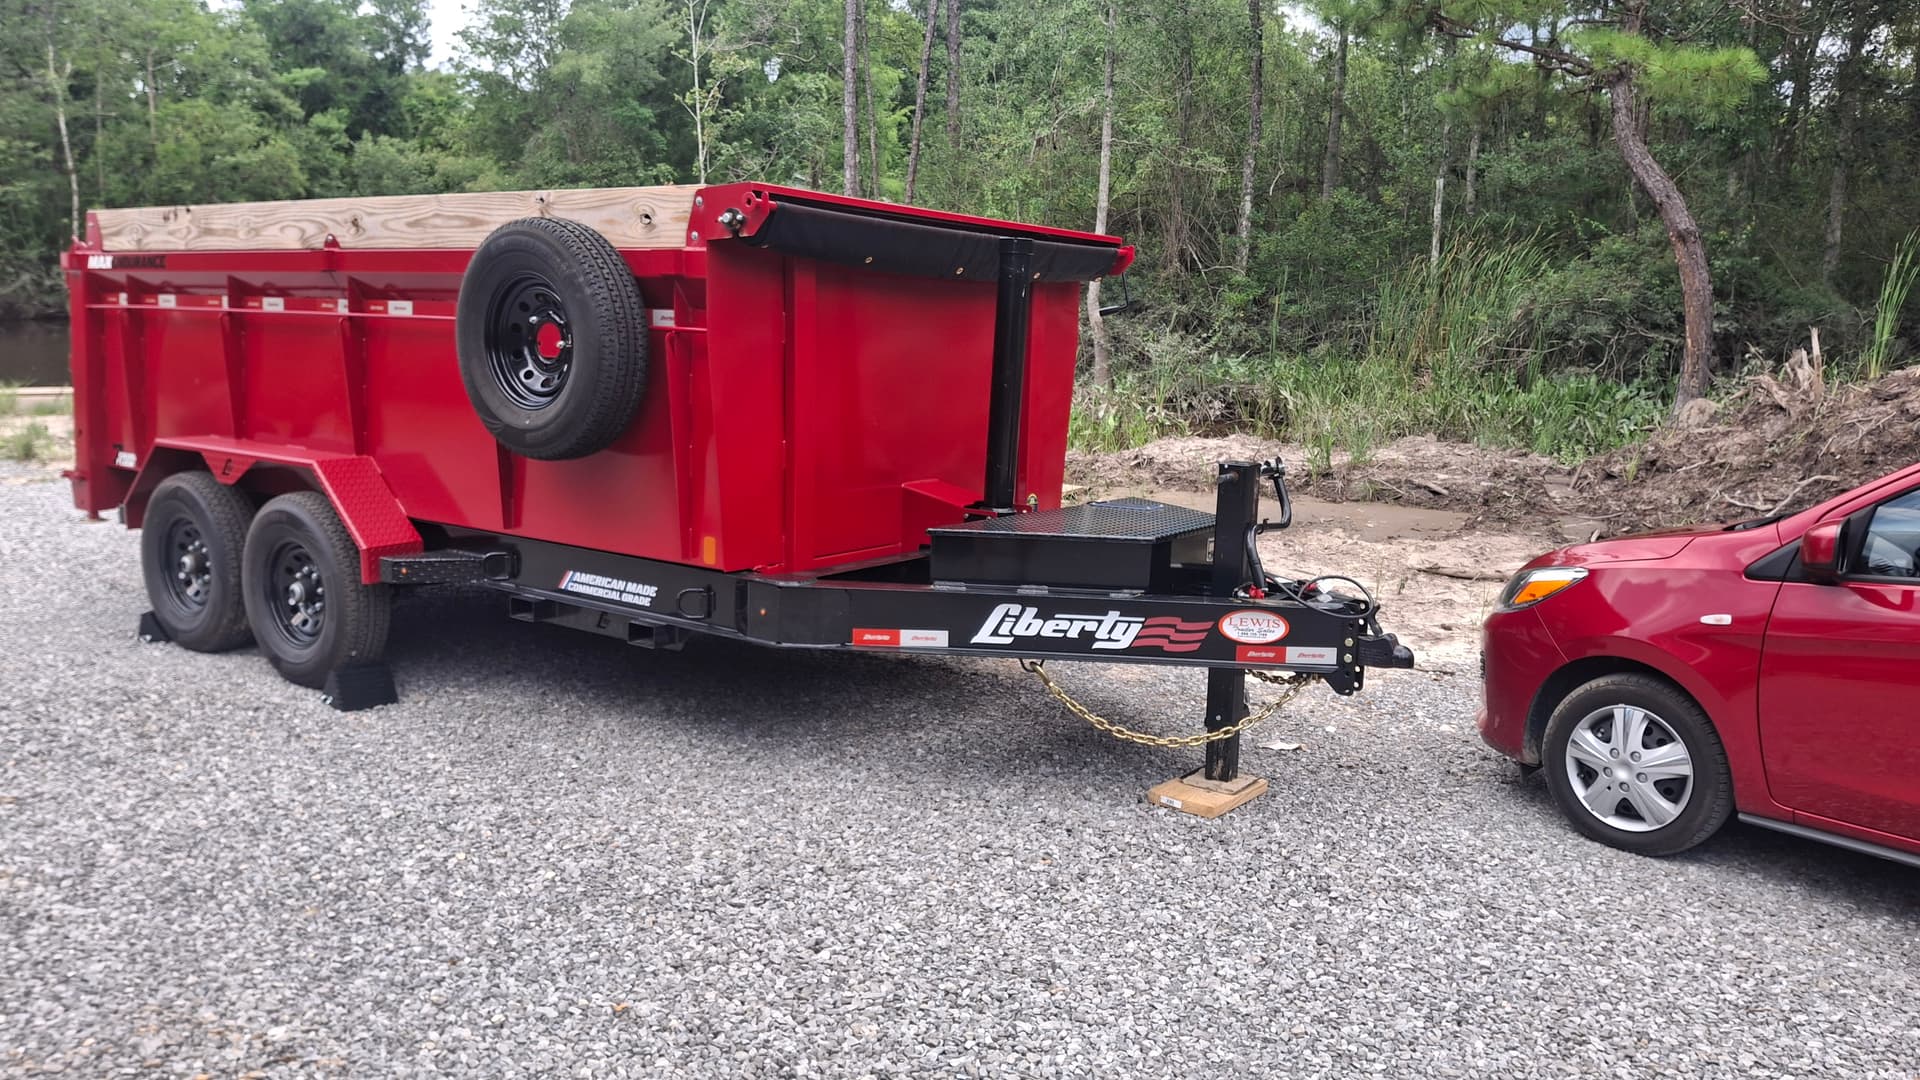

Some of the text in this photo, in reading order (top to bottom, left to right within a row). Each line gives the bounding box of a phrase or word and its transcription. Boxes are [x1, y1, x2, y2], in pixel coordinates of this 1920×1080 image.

[567, 582, 652, 607] COMMERCIAL GRADE
[573, 571, 658, 597] AMERICAN MADE
[970, 603, 1146, 649] Liberty
[1229, 617, 1281, 628] LEWIS
